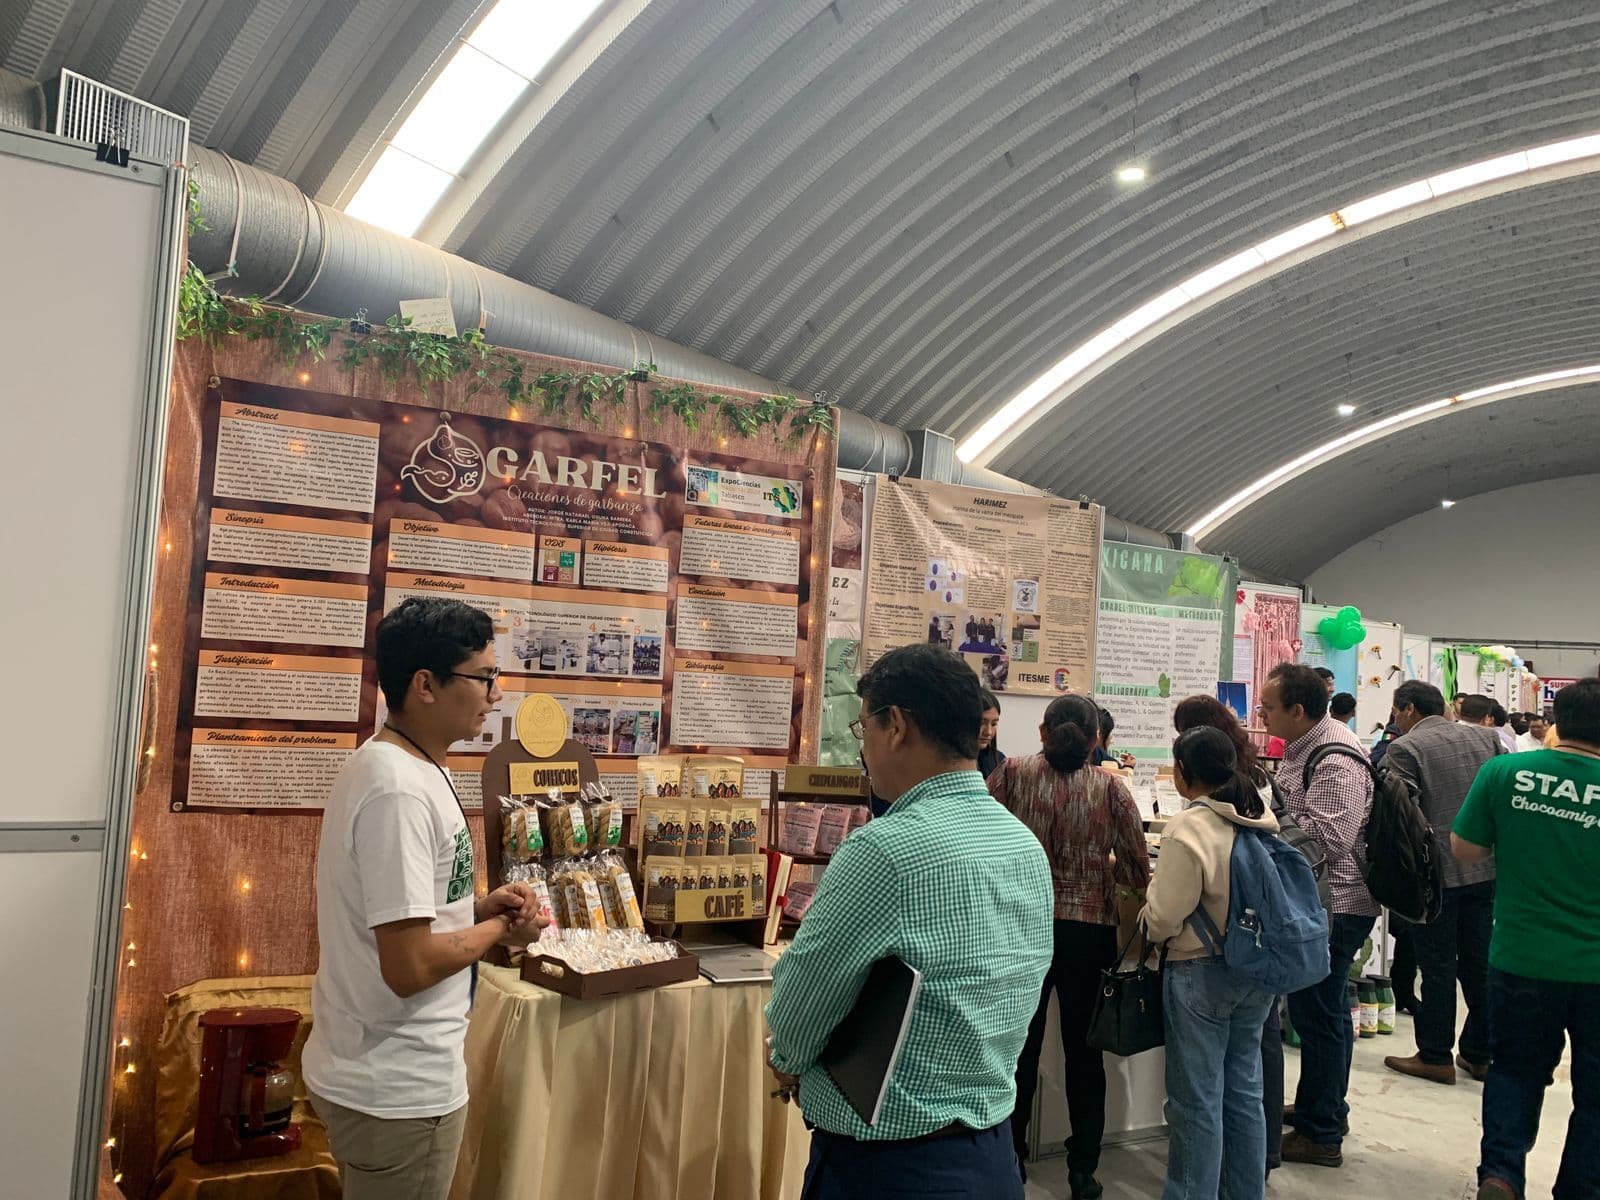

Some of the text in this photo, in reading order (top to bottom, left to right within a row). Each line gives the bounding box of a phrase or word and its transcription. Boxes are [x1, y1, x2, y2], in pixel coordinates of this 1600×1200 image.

[235, 407, 279, 420] Abstract
[486, 446, 667, 499] GARFEL
[507, 484, 644, 516] Creaciones de garbanzo
[973, 498, 1008, 509] HARIMEZ
[226, 512, 264, 526] Sinopsis
[404, 522, 439, 532] Objetivo
[592, 543, 627, 554] Hipótesis
[220, 577, 280, 590] Introducción
[413, 577, 466, 589] Metodología
[513, 617, 522, 627] 3
[589, 622, 597, 632] 4
[634, 625, 641, 634] 5
[213, 655, 273, 666] Justificación
[1019, 674, 1050, 684] ITESME
[206, 732, 336, 745] Planteamiento del problema
[1512, 795, 1600, 828] Chocoamig
[704, 890, 744, 919] CAFÉ
